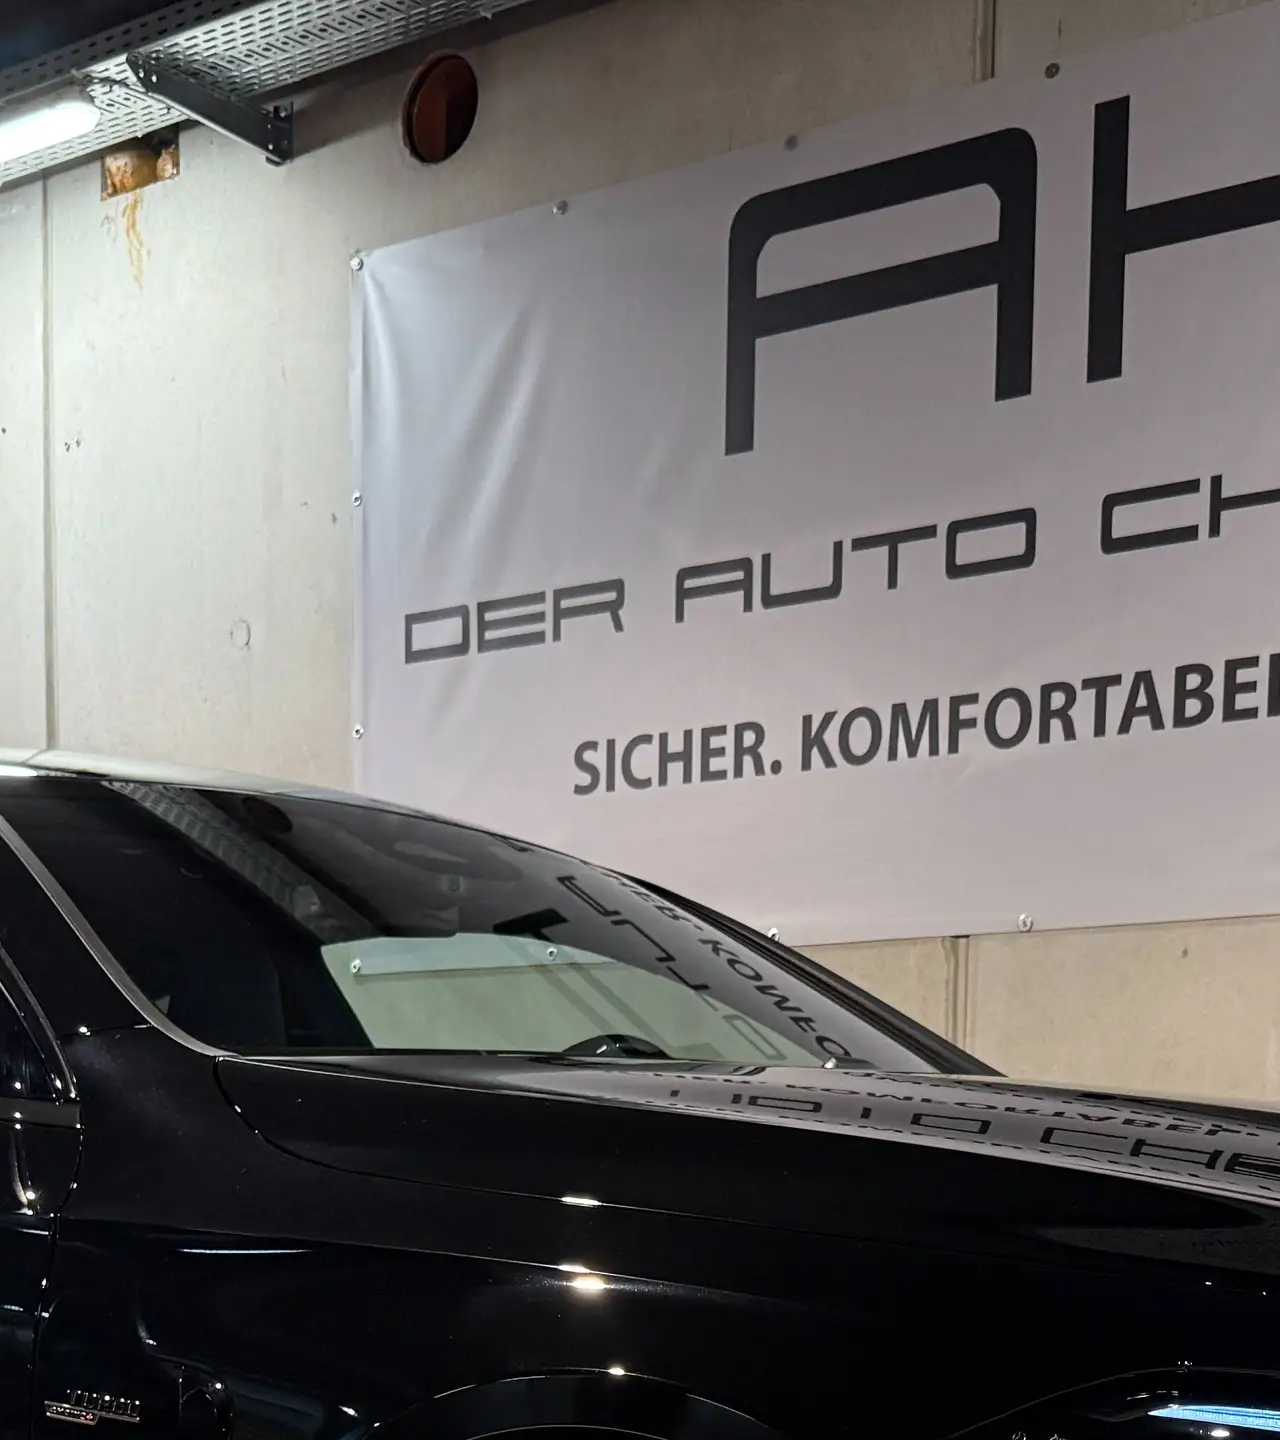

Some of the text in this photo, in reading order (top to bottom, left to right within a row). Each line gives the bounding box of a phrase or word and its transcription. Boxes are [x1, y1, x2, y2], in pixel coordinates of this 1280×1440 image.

[404, 577, 626, 665] DER
[675, 507, 1038, 623] AUTO
[573, 721, 783, 796] SICHER.
